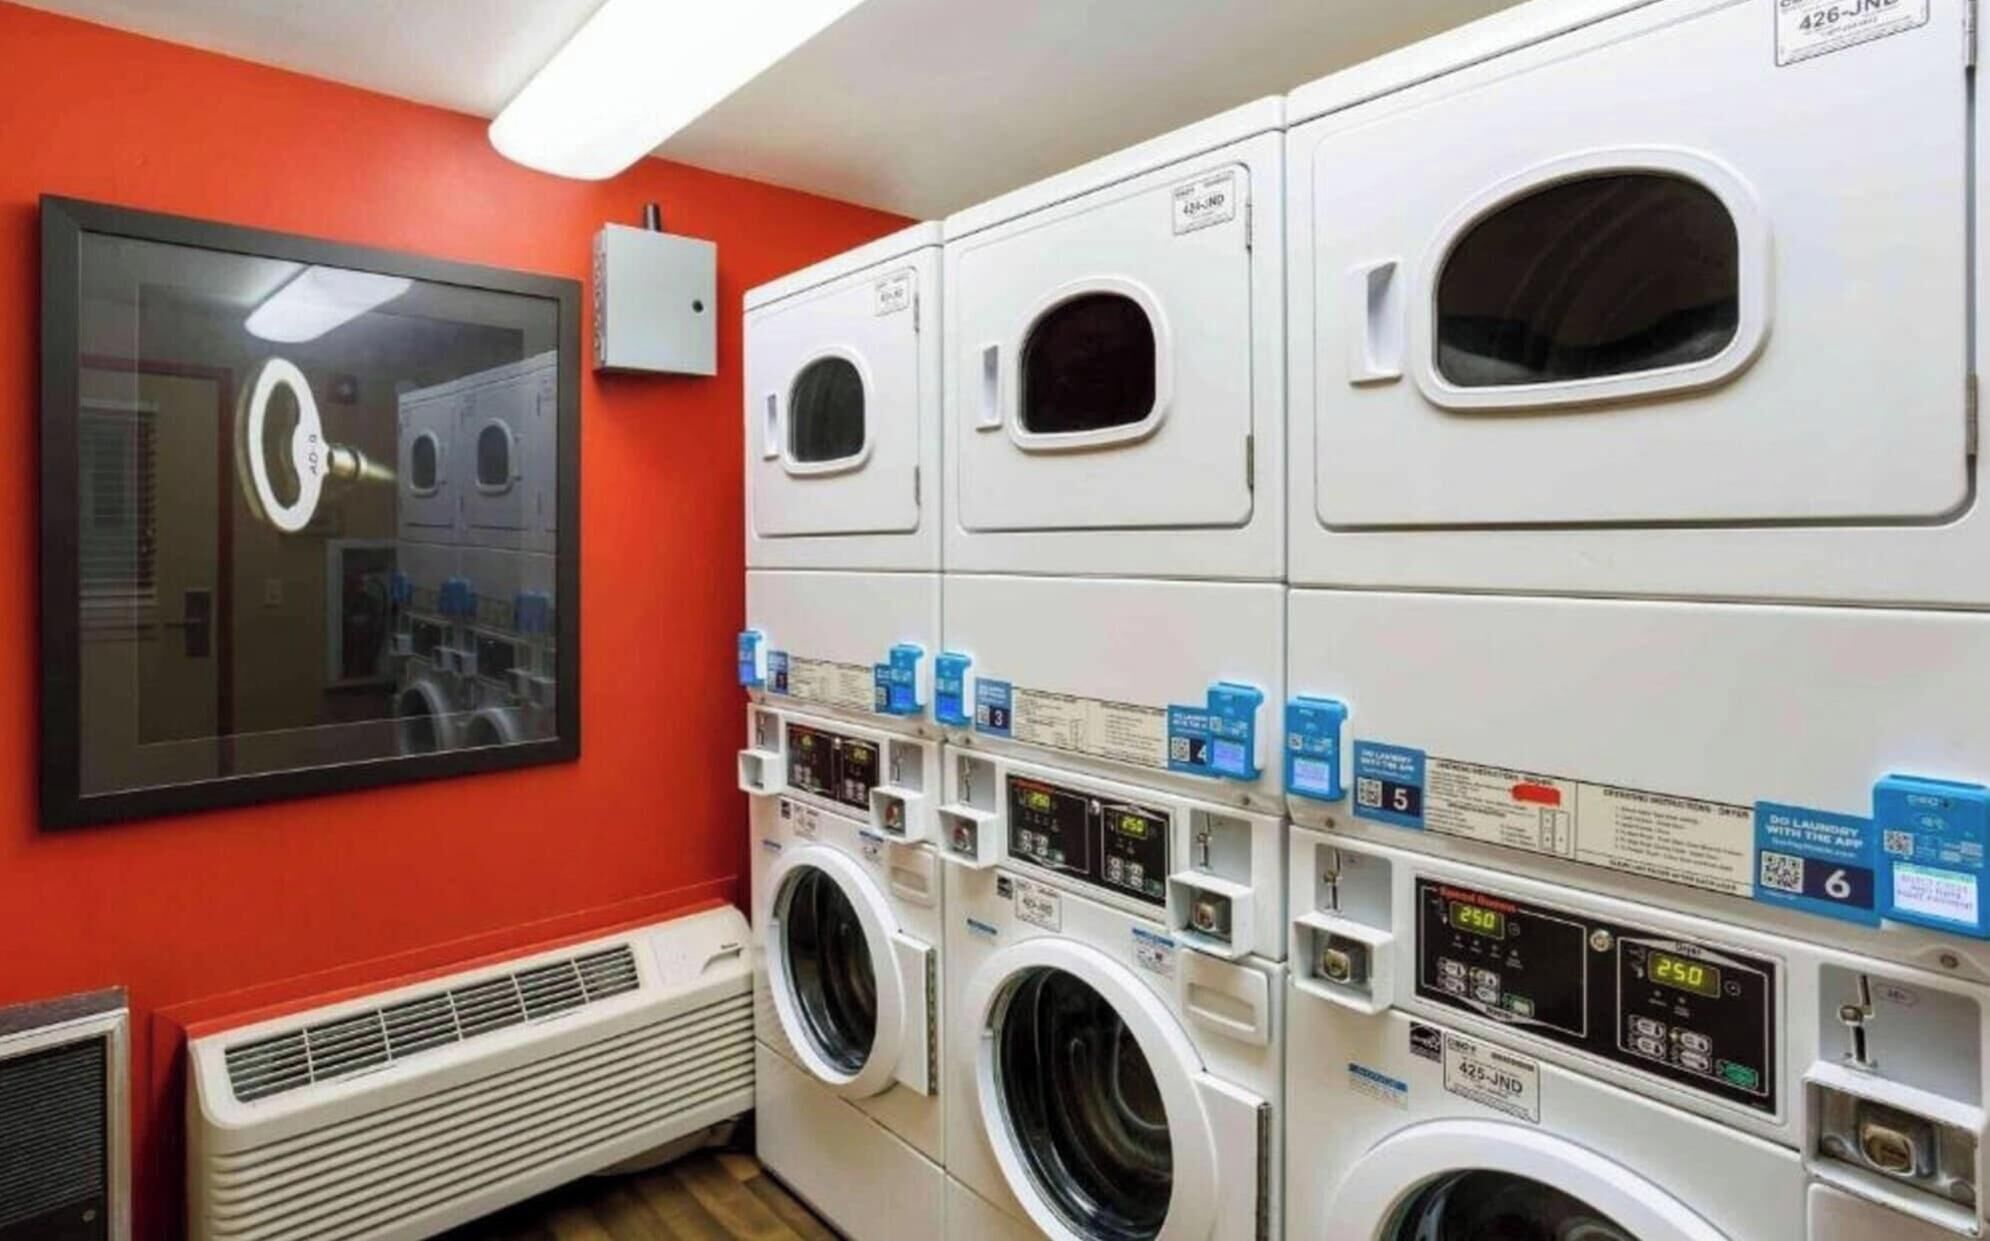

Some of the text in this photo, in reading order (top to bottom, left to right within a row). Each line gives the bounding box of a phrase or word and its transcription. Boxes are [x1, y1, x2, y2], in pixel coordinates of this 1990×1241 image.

[994, 709, 1003, 726] 3
[1393, 788, 1408, 811] 5
[1765, 824, 1801, 838] WITH
[1805, 830, 1832, 844] THE
[1835, 837, 1863, 849] APP
[1769, 814, 1859, 837] DO LAUNDRY
[1825, 869, 1851, 899] 6
[1460, 906, 1495, 929] 250
[1657, 959, 1703, 985] 250
[1459, 1061, 1523, 1094] 425-JND
